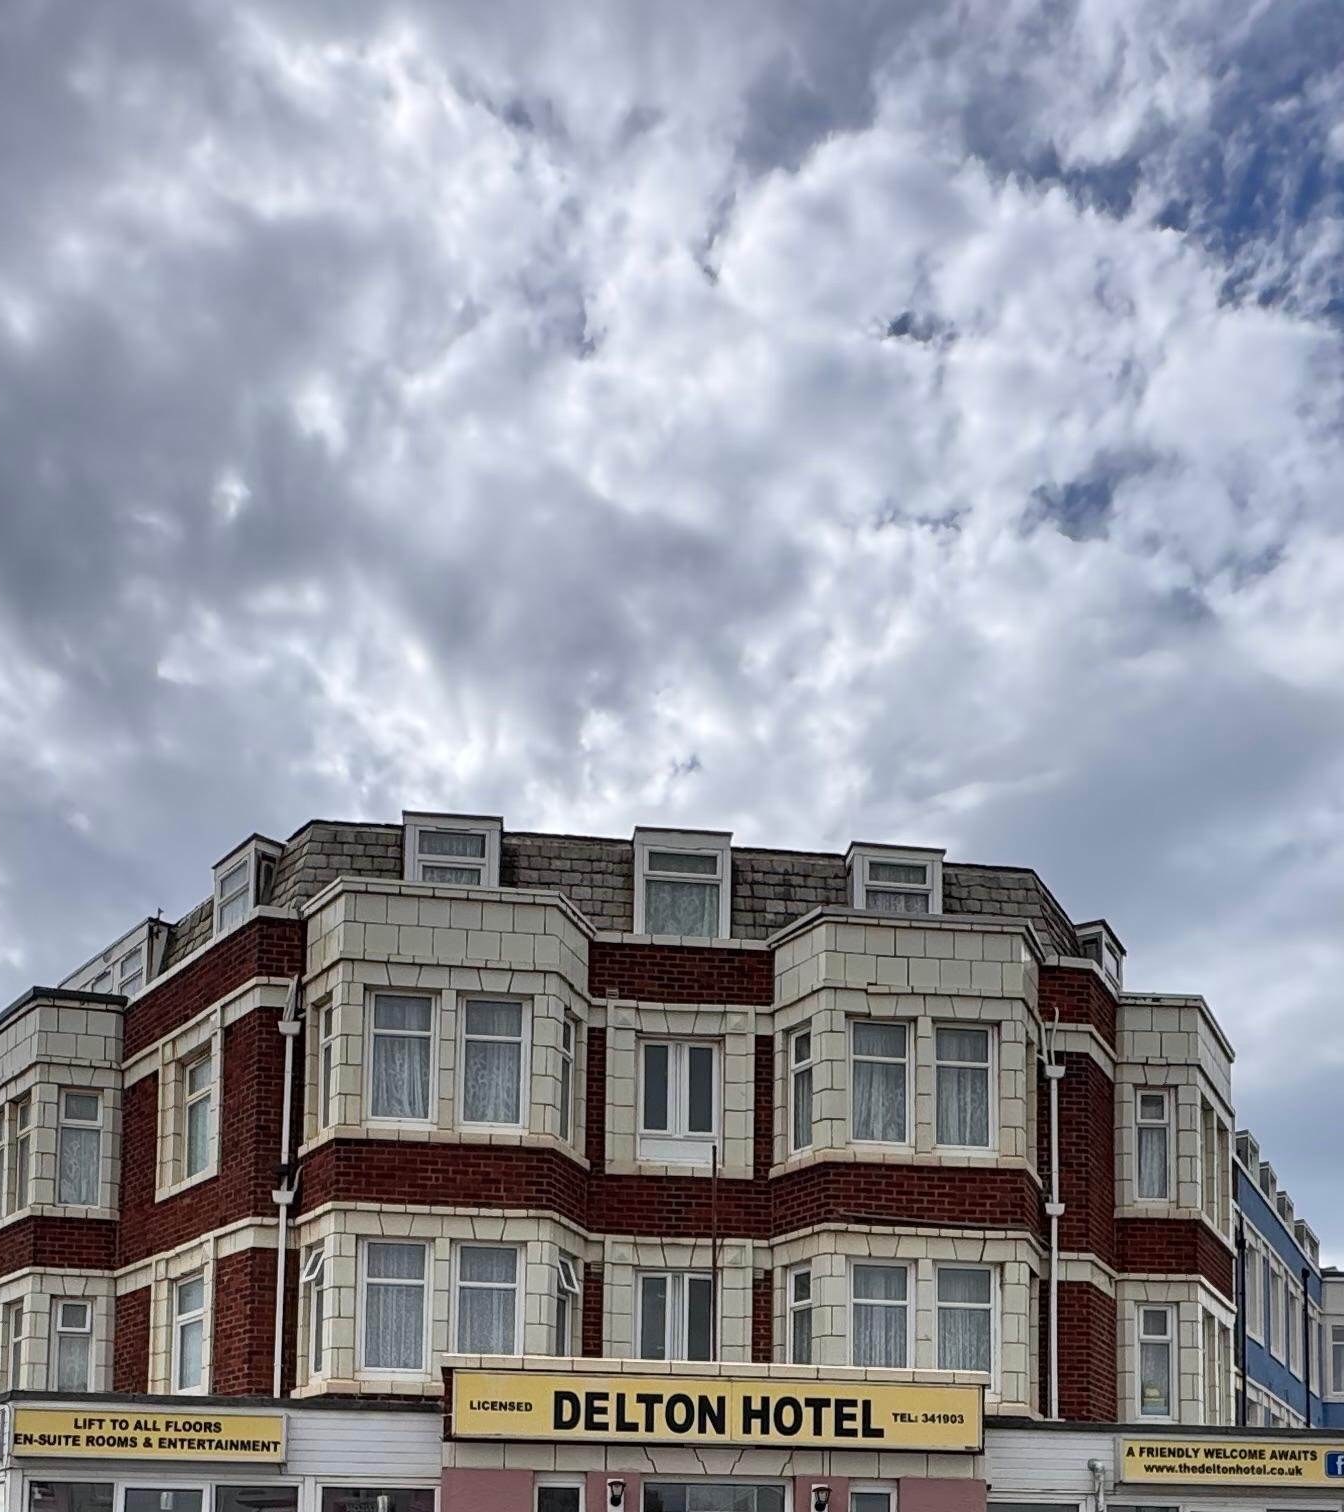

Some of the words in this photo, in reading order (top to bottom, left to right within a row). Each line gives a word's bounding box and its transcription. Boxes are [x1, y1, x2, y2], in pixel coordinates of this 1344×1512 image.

[469, 1400, 533, 1412] LICENSED
[553, 1390, 726, 1434] DELTON
[742, 1395, 885, 1438] HOTEL
[892, 1413, 918, 1423] TEL:
[921, 1413, 964, 1424] 341903
[74, 1418, 106, 1430] LIFT
[109, 1419, 129, 1430] TO
[133, 1420, 161, 1431] ALL
[165, 1421, 222, 1433] FLOORS
[14, 1433, 81, 1447] EN-SUITE
[86, 1436, 137, 1448] ROOMS
[143, 1437, 153, 1448] &
[158, 1438, 281, 1452] ENTERTAINMENT
[1126, 1446, 1136, 1457] A
[1139, 1447, 1201, 1458] FRIENDLY
[1203, 1448, 1266, 1460] WELCOME
[1270, 1450, 1318, 1461] AWAITS
[1143, 1463, 1303, 1476] www.thedeltonhotel.co.uk
